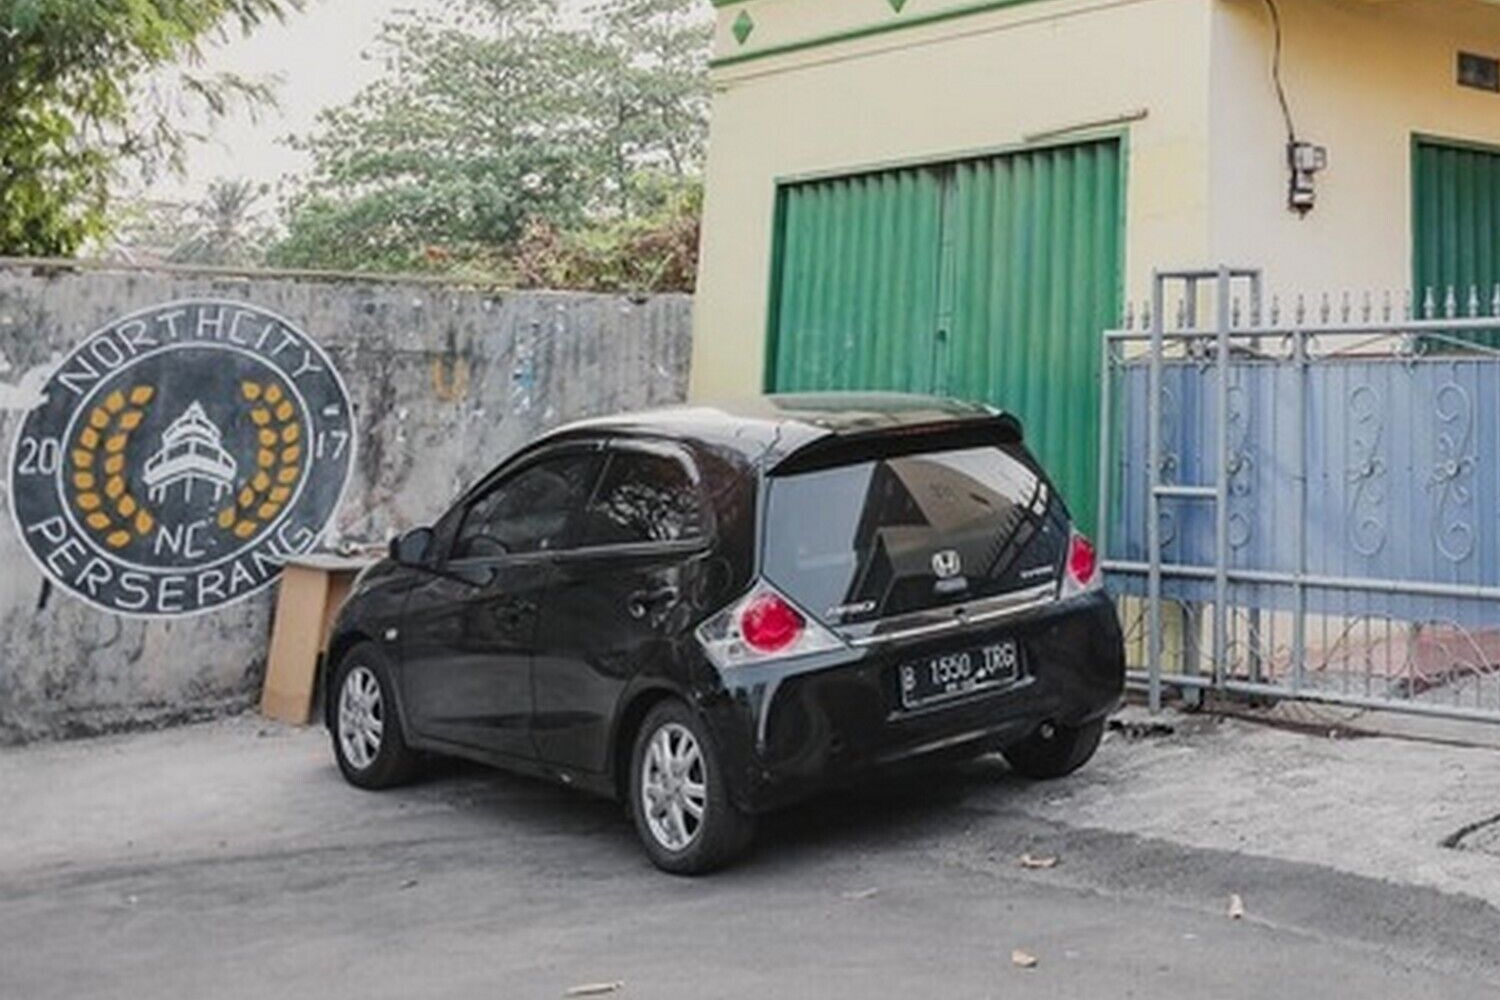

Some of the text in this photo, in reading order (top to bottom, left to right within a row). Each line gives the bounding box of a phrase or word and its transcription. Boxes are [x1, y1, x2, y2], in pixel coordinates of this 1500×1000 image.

[57, 308, 322, 395] NORTHCITY
[18, 431, 348, 476] 20 17
[155, 521, 207, 559] NC
[27, 516, 313, 611] PERSERANG
[902, 666, 916, 691] B
